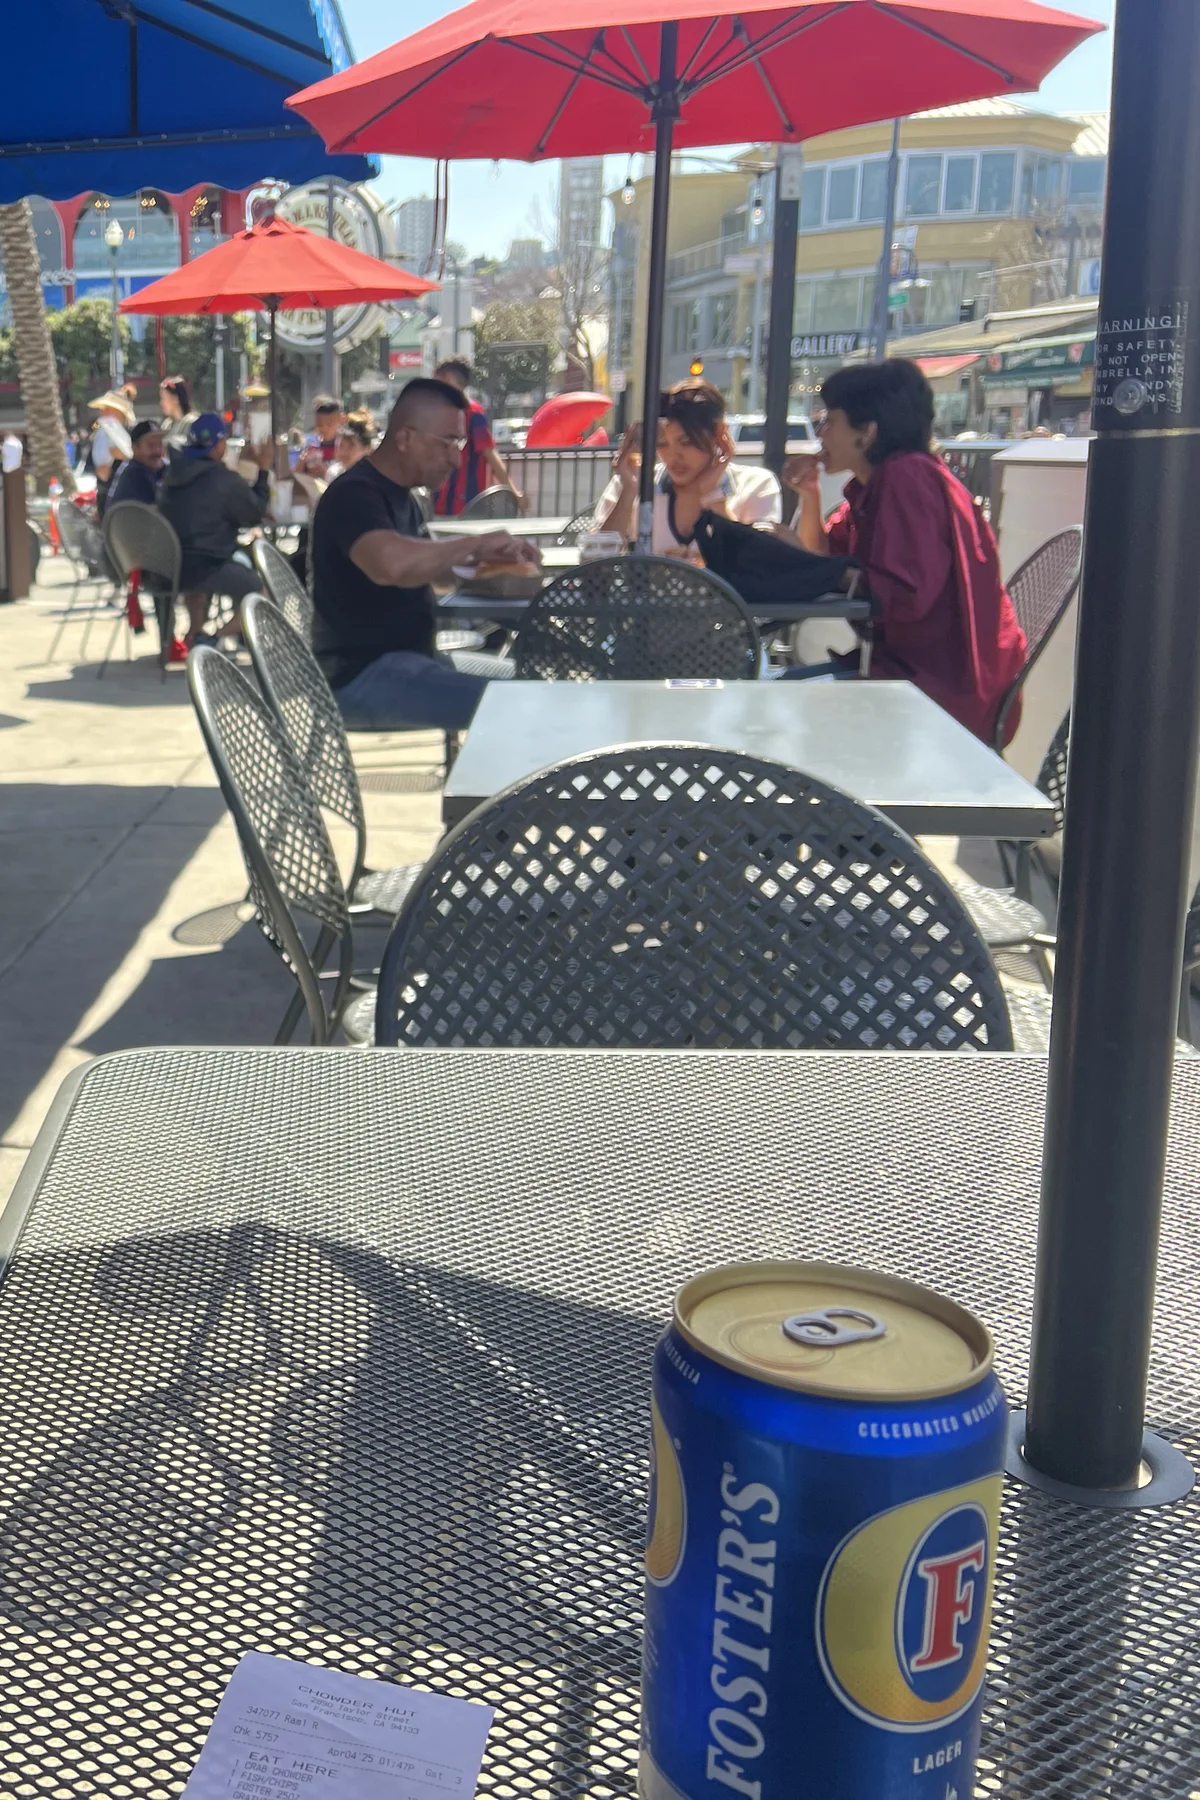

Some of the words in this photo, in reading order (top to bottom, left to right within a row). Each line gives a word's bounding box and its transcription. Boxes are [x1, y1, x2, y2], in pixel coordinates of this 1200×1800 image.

[790, 333, 856, 358] GALLERY
[1096, 344, 1109, 353] OR
[1108, 356, 1129, 365] NOT
[1140, 353, 1176, 363] OPEN
[1161, 365, 1176, 374] IN
[1143, 380, 1174, 390] NDY
[858, 1416, 959, 1439] CELEBRATED
[910, 1538, 984, 1673] F
[706, 1470, 780, 1800] FOSTER'S
[298, 1685, 374, 1709] CHOWDER
[384, 1706, 418, 1717] HUT
[246, 1705, 280, 1720] 347077
[312, 1721, 319, 1729] R
[291, 1699, 308, 1709] San
[373, 1720, 385, 1728] CA
[391, 1723, 420, 1735] 94133
[339, 1704, 371, 1716] Taylor
[376, 1712, 411, 1725] Street
[233, 1725, 251, 1736] Chk
[255, 1730, 279, 1743] 5757
[425, 1768, 443, 1780] Gst
[454, 1776, 462, 1785] 3
[249, 1751, 282, 1765] EAT
[292, 1760, 340, 1779] HERE
[913, 1740, 962, 1775] LAGER
[240, 1771, 299, 1791] FISH/CHIPS
[244, 1761, 268, 1773] CRAB
[272, 1767, 314, 1783] CHOWDER
[237, 1781, 272, 1796] FOSTER
